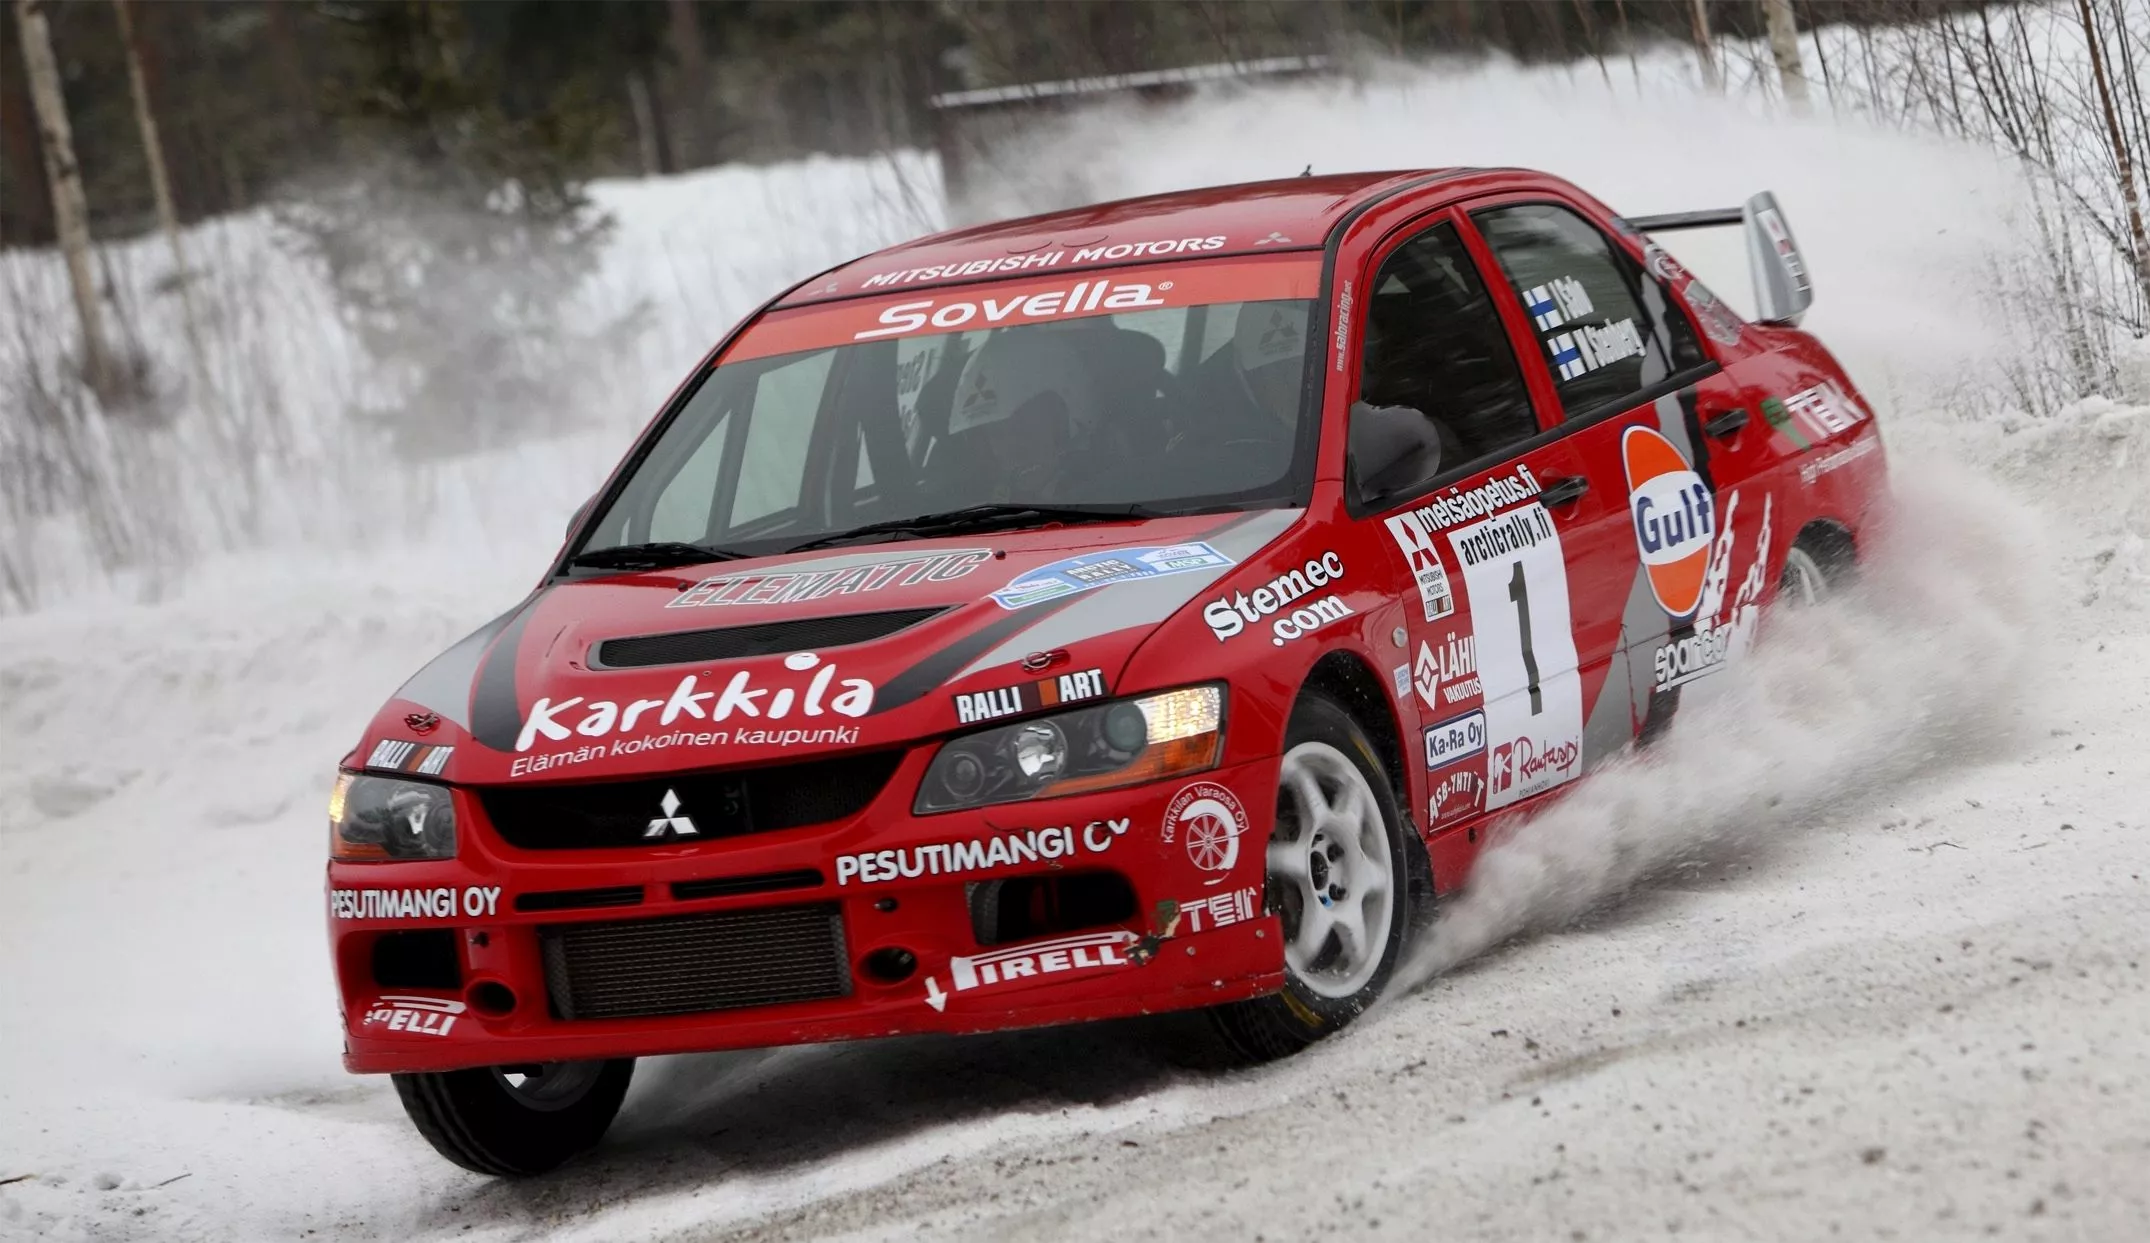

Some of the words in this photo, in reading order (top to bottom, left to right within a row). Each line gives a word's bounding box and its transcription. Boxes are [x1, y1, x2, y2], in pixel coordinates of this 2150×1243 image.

[861, 250, 1064, 288] MITSUBISHI
[1070, 235, 1227, 263] MOTORS
[1415, 463, 1542, 533] metsäopetus.fi
[1636, 483, 1711, 554] Gulf
[1461, 507, 1552, 566] arcticrally.fi
[664, 548, 993, 609] ELEMATIC
[1203, 552, 1345, 643] Stemec
[1270, 592, 1355, 647] .com
[1508, 560, 1543, 717] 1
[1439, 631, 1477, 682] LÄHI
[1655, 627, 1727, 692] sparco
[515, 652, 875, 752] Karkkila
[958, 686, 1023, 724] RALLI
[1059, 669, 1104, 702] ART
[1443, 677, 1482, 704] VAKUUTUS
[510, 744, 605, 778] Elämän
[610, 729, 728, 757] kokoinen
[733, 727, 860, 748] kaupunki
[1429, 728, 1465, 758] Ka-Ra
[1468, 722, 1483, 746] Oy
[1163, 792, 1195, 843] Karkkilan
[1193, 786, 1237, 810] Varaosa
[1235, 811, 1246, 830] Oy
[1429, 770, 1485, 827] ASB-YHTIT
[836, 826, 1075, 886] PESUTIMANGI
[331, 888, 458, 918] PESUTIMANGI
[463, 886, 501, 916] OY
[951, 930, 1140, 992] PIRELL
